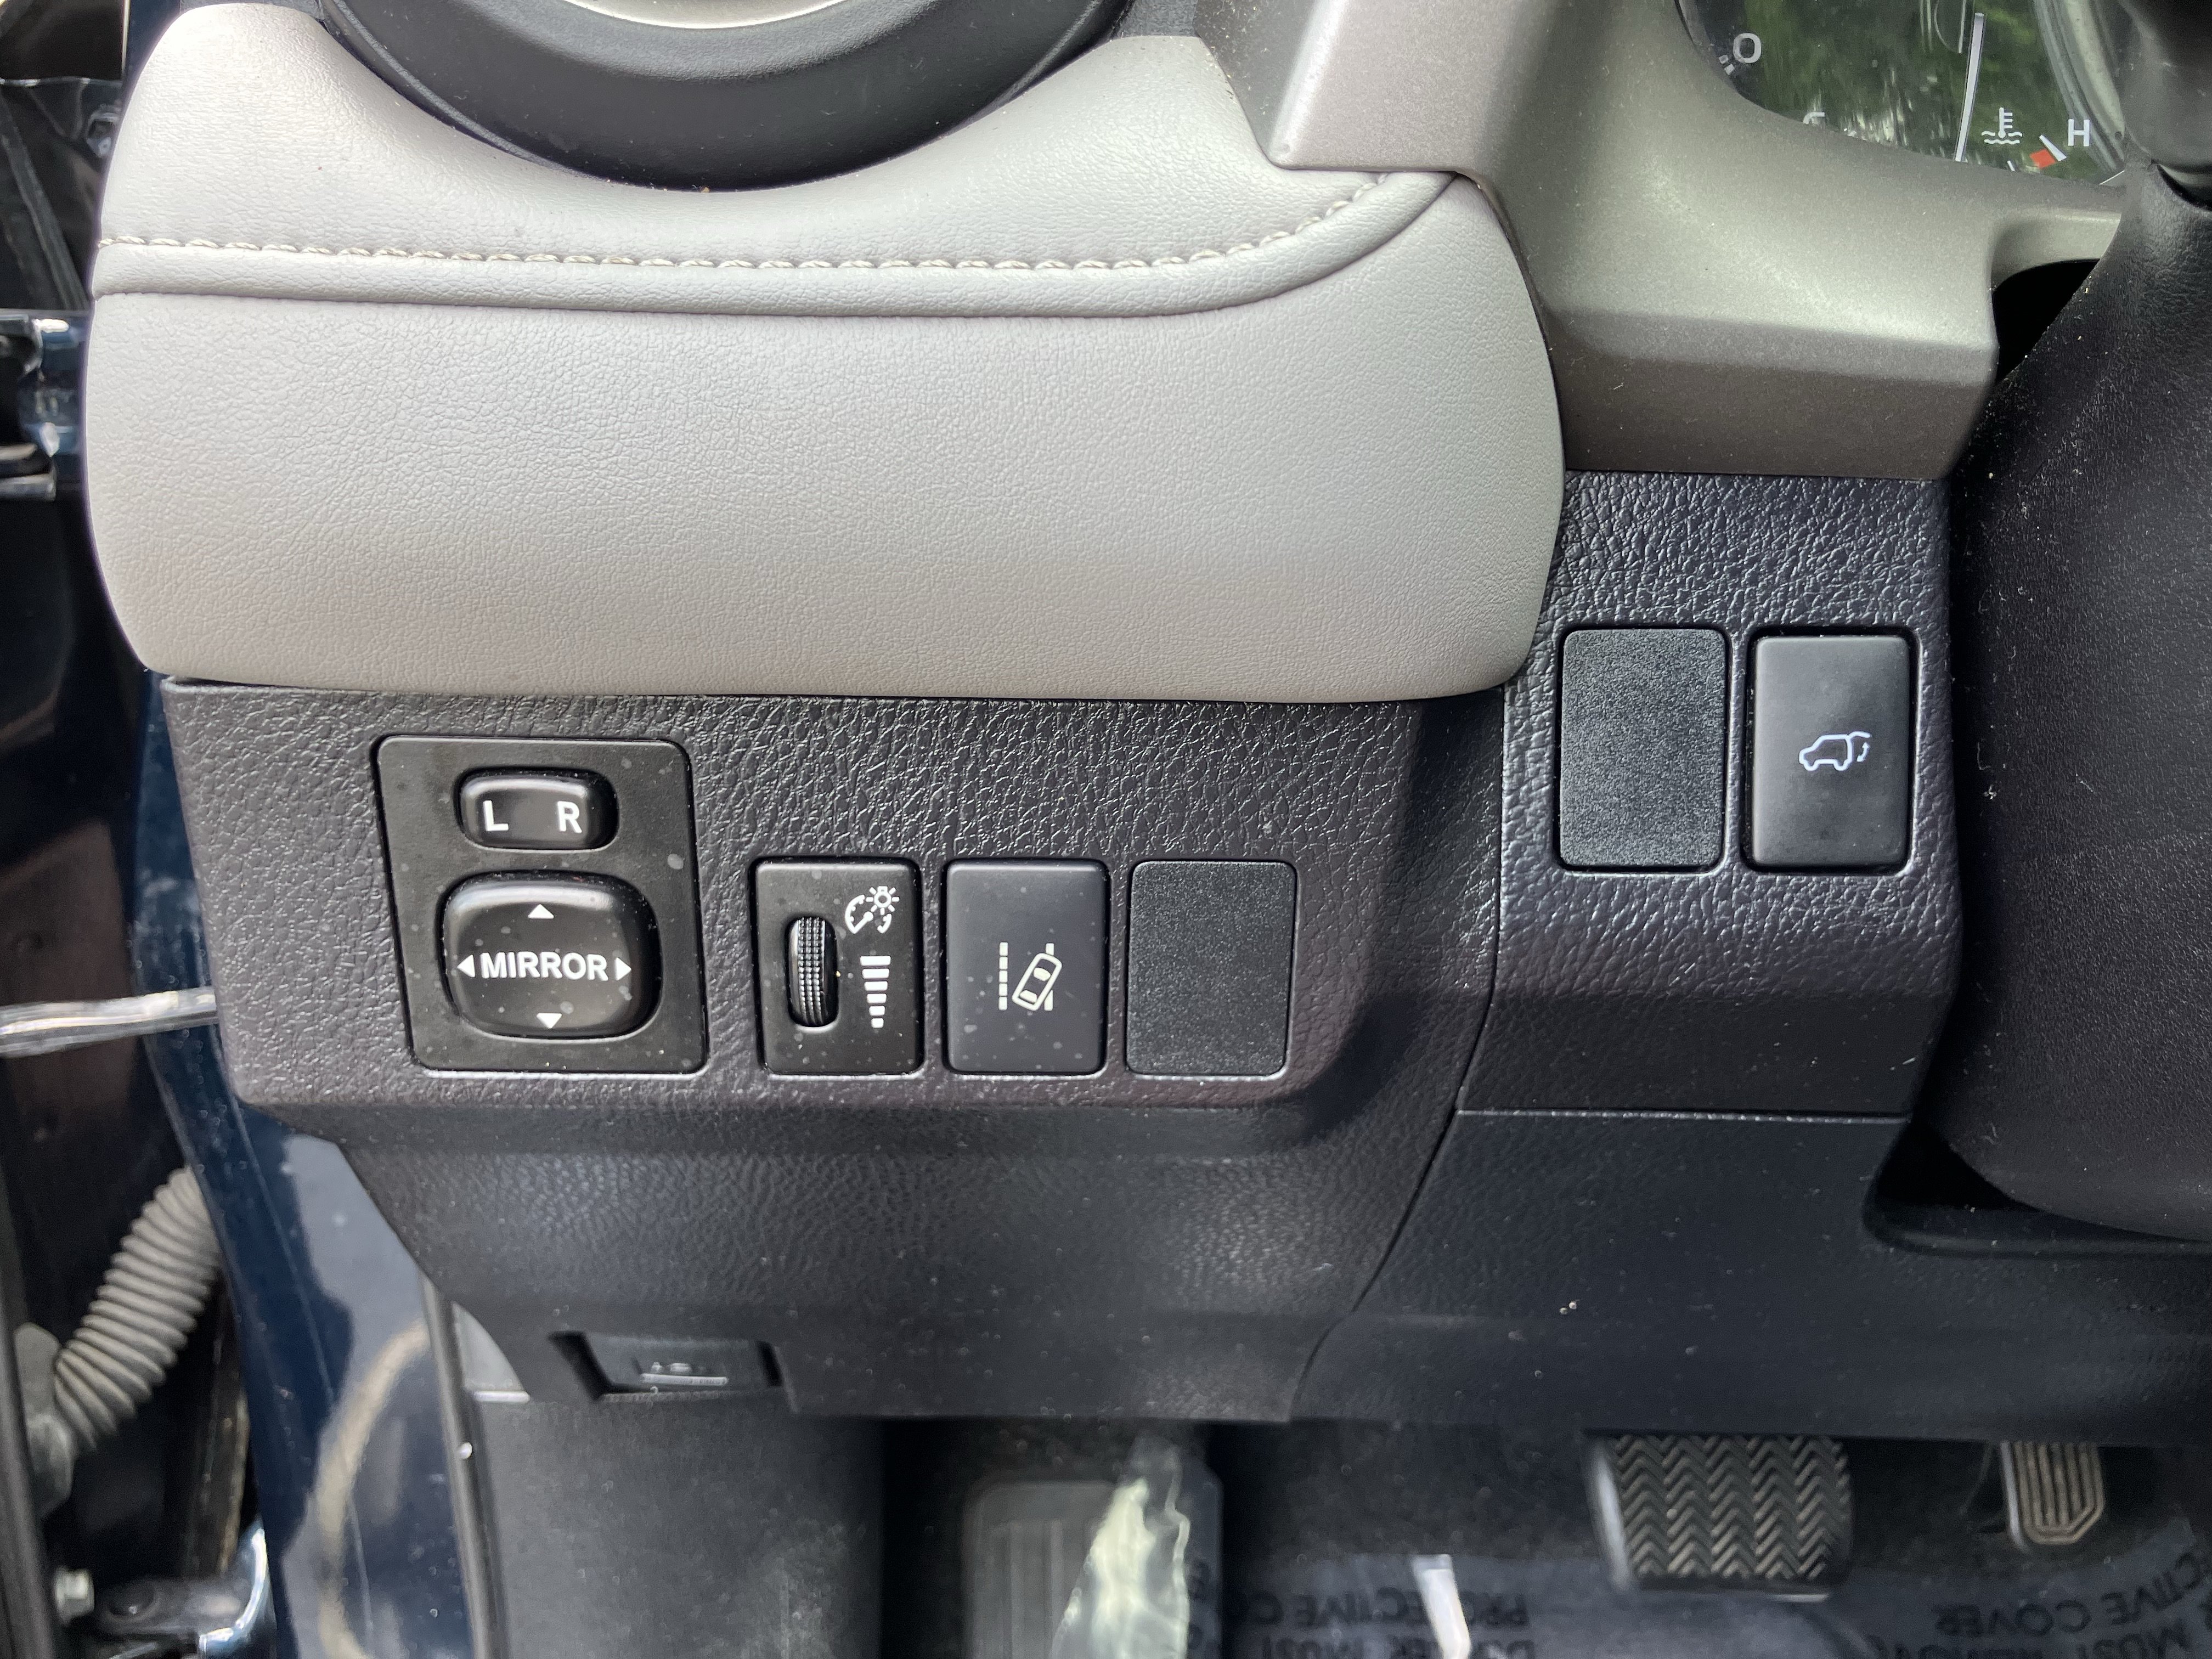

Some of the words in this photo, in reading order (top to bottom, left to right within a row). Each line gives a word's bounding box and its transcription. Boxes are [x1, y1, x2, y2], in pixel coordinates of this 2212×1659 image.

[2067, 118, 2091, 147] H
[482, 799, 510, 832] L
[555, 800, 583, 834] R
[479, 951, 610, 982] MIRROR
